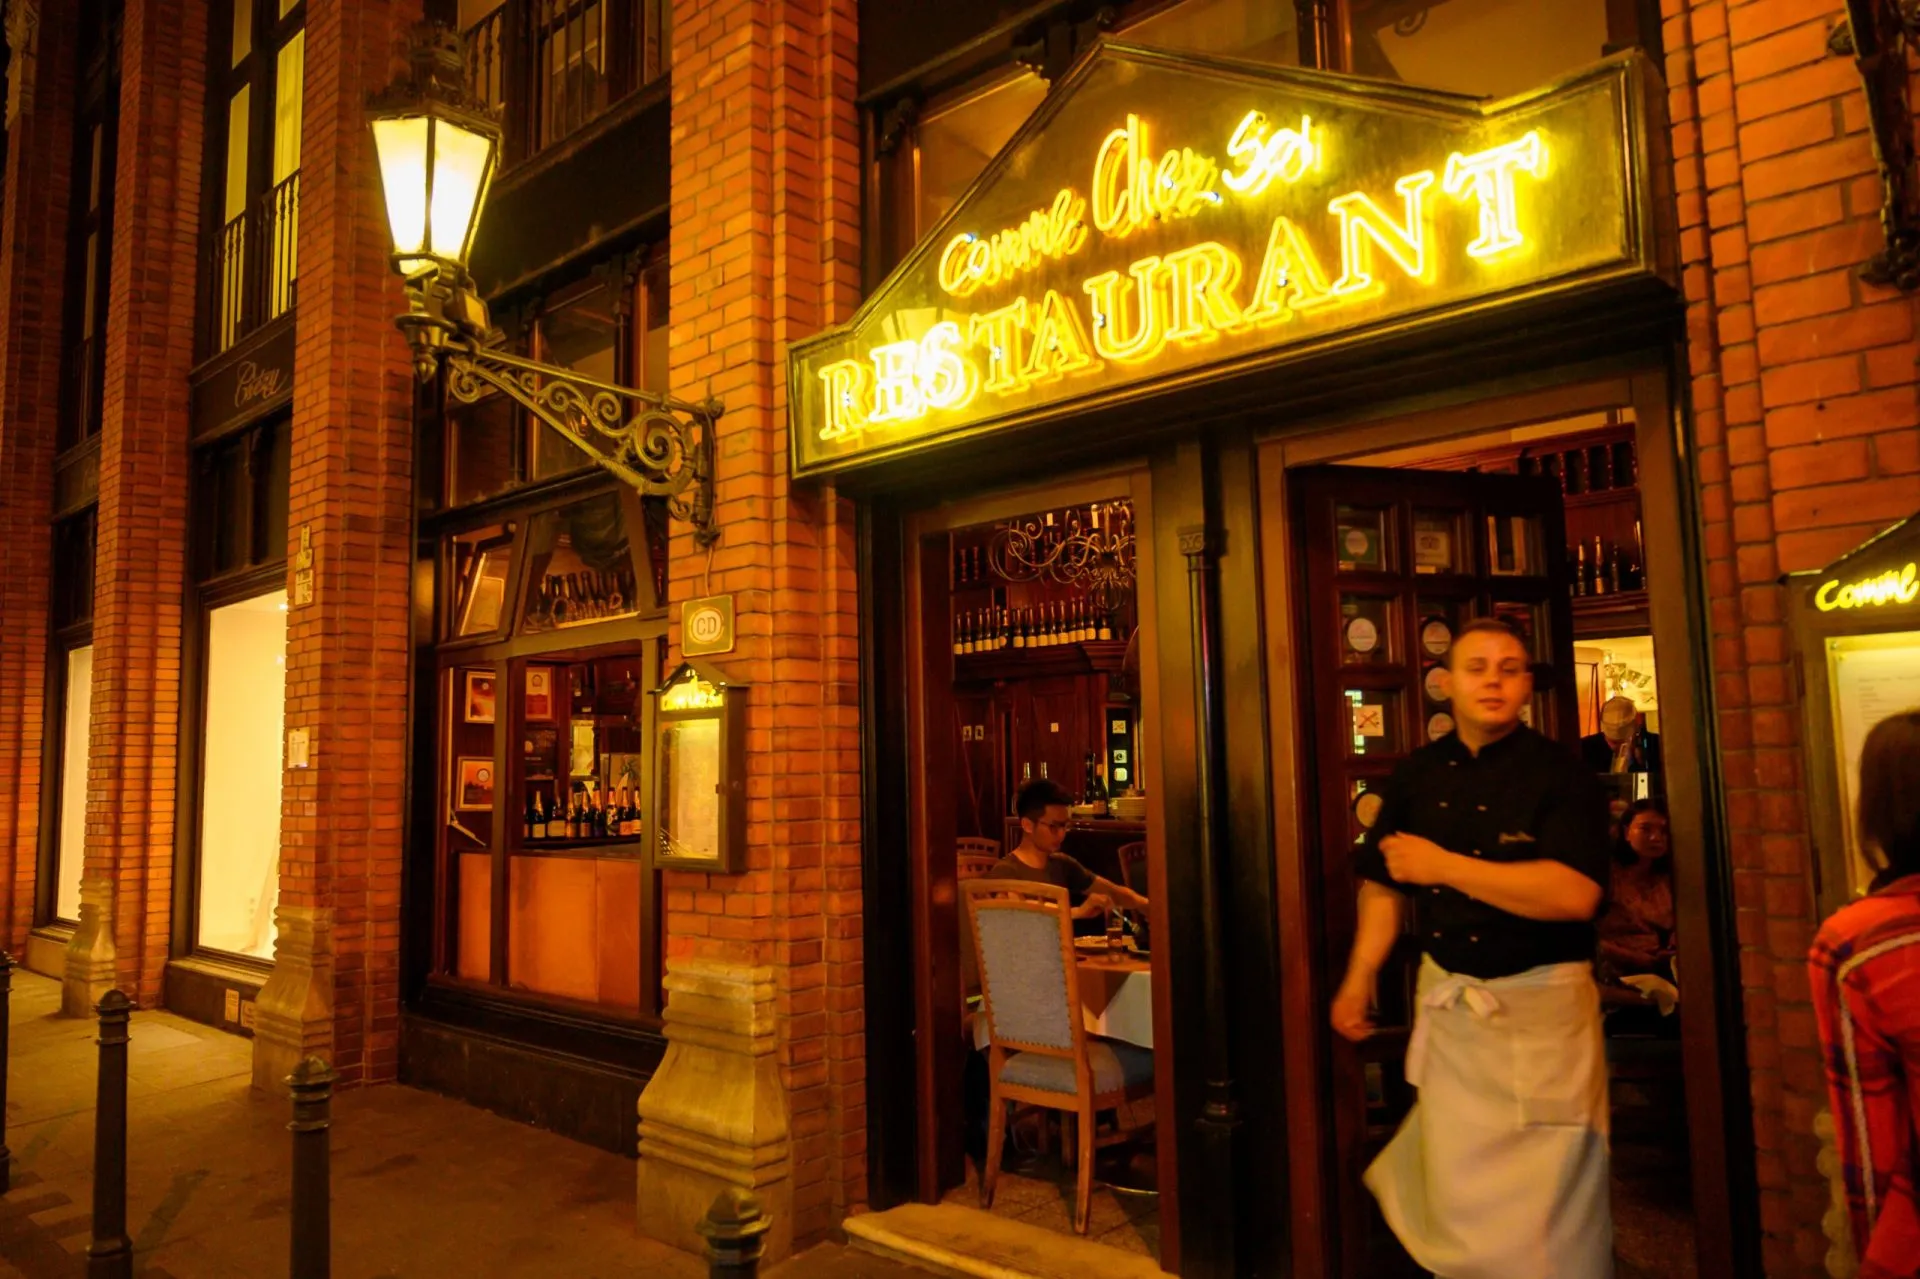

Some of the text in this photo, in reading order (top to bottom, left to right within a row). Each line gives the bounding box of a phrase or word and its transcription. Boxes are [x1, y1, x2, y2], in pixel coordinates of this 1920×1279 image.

[1092, 112, 1222, 238] Chez
[819, 128, 1547, 442] RESTAURANT
[696, 616, 717, 636] CD
